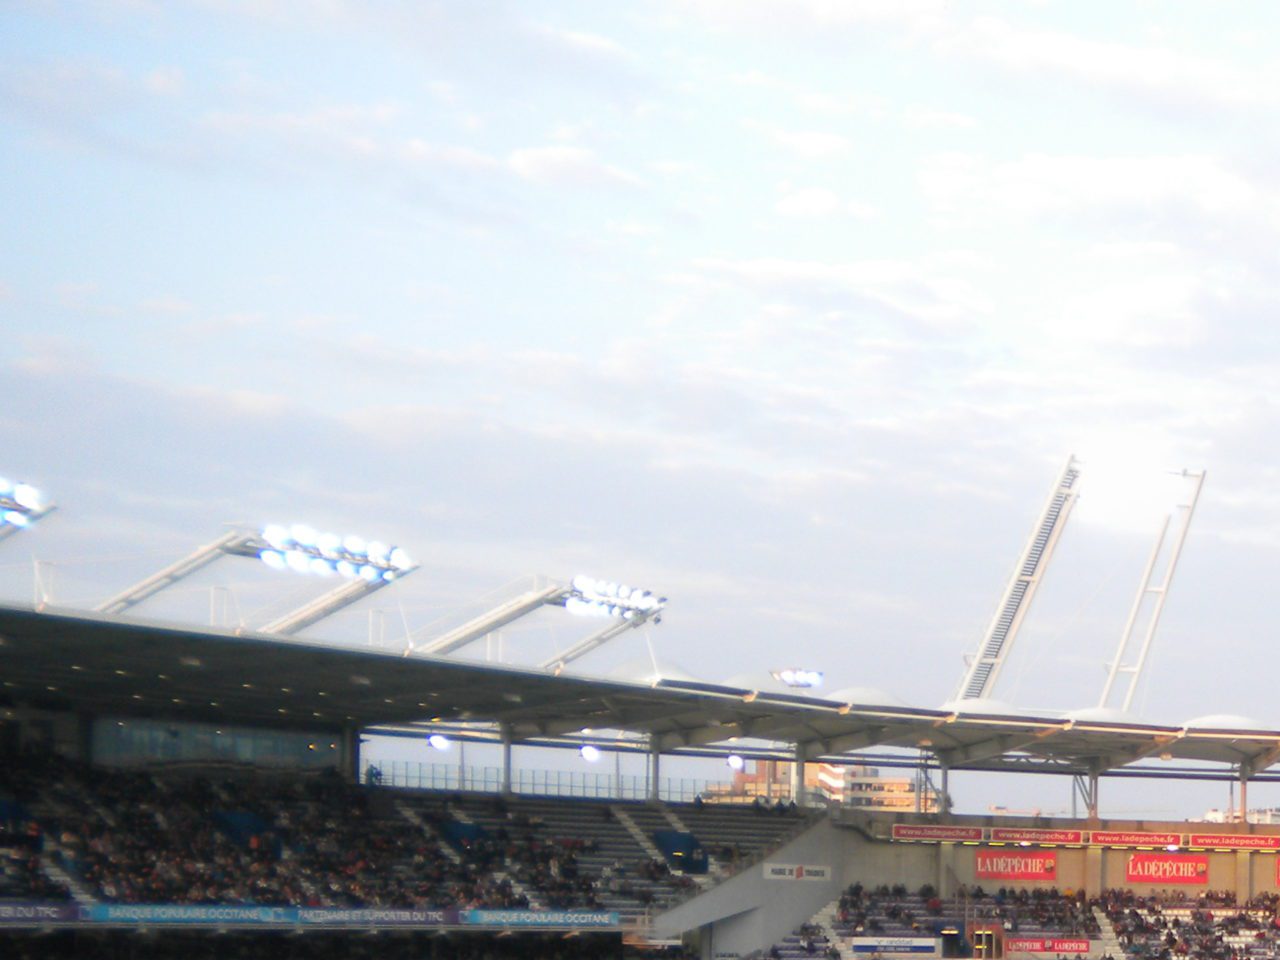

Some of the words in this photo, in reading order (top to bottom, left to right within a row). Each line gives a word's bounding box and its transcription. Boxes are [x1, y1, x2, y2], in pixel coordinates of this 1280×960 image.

[998, 830, 1075, 841] www.ladepeche.fr
[1097, 832, 1175, 844] www.ladepeche.fr
[1197, 835, 1274, 846] www.ladepeche.fr
[109, 907, 150, 920] BANQUE
[567, 912, 609, 924] OCCITANE
